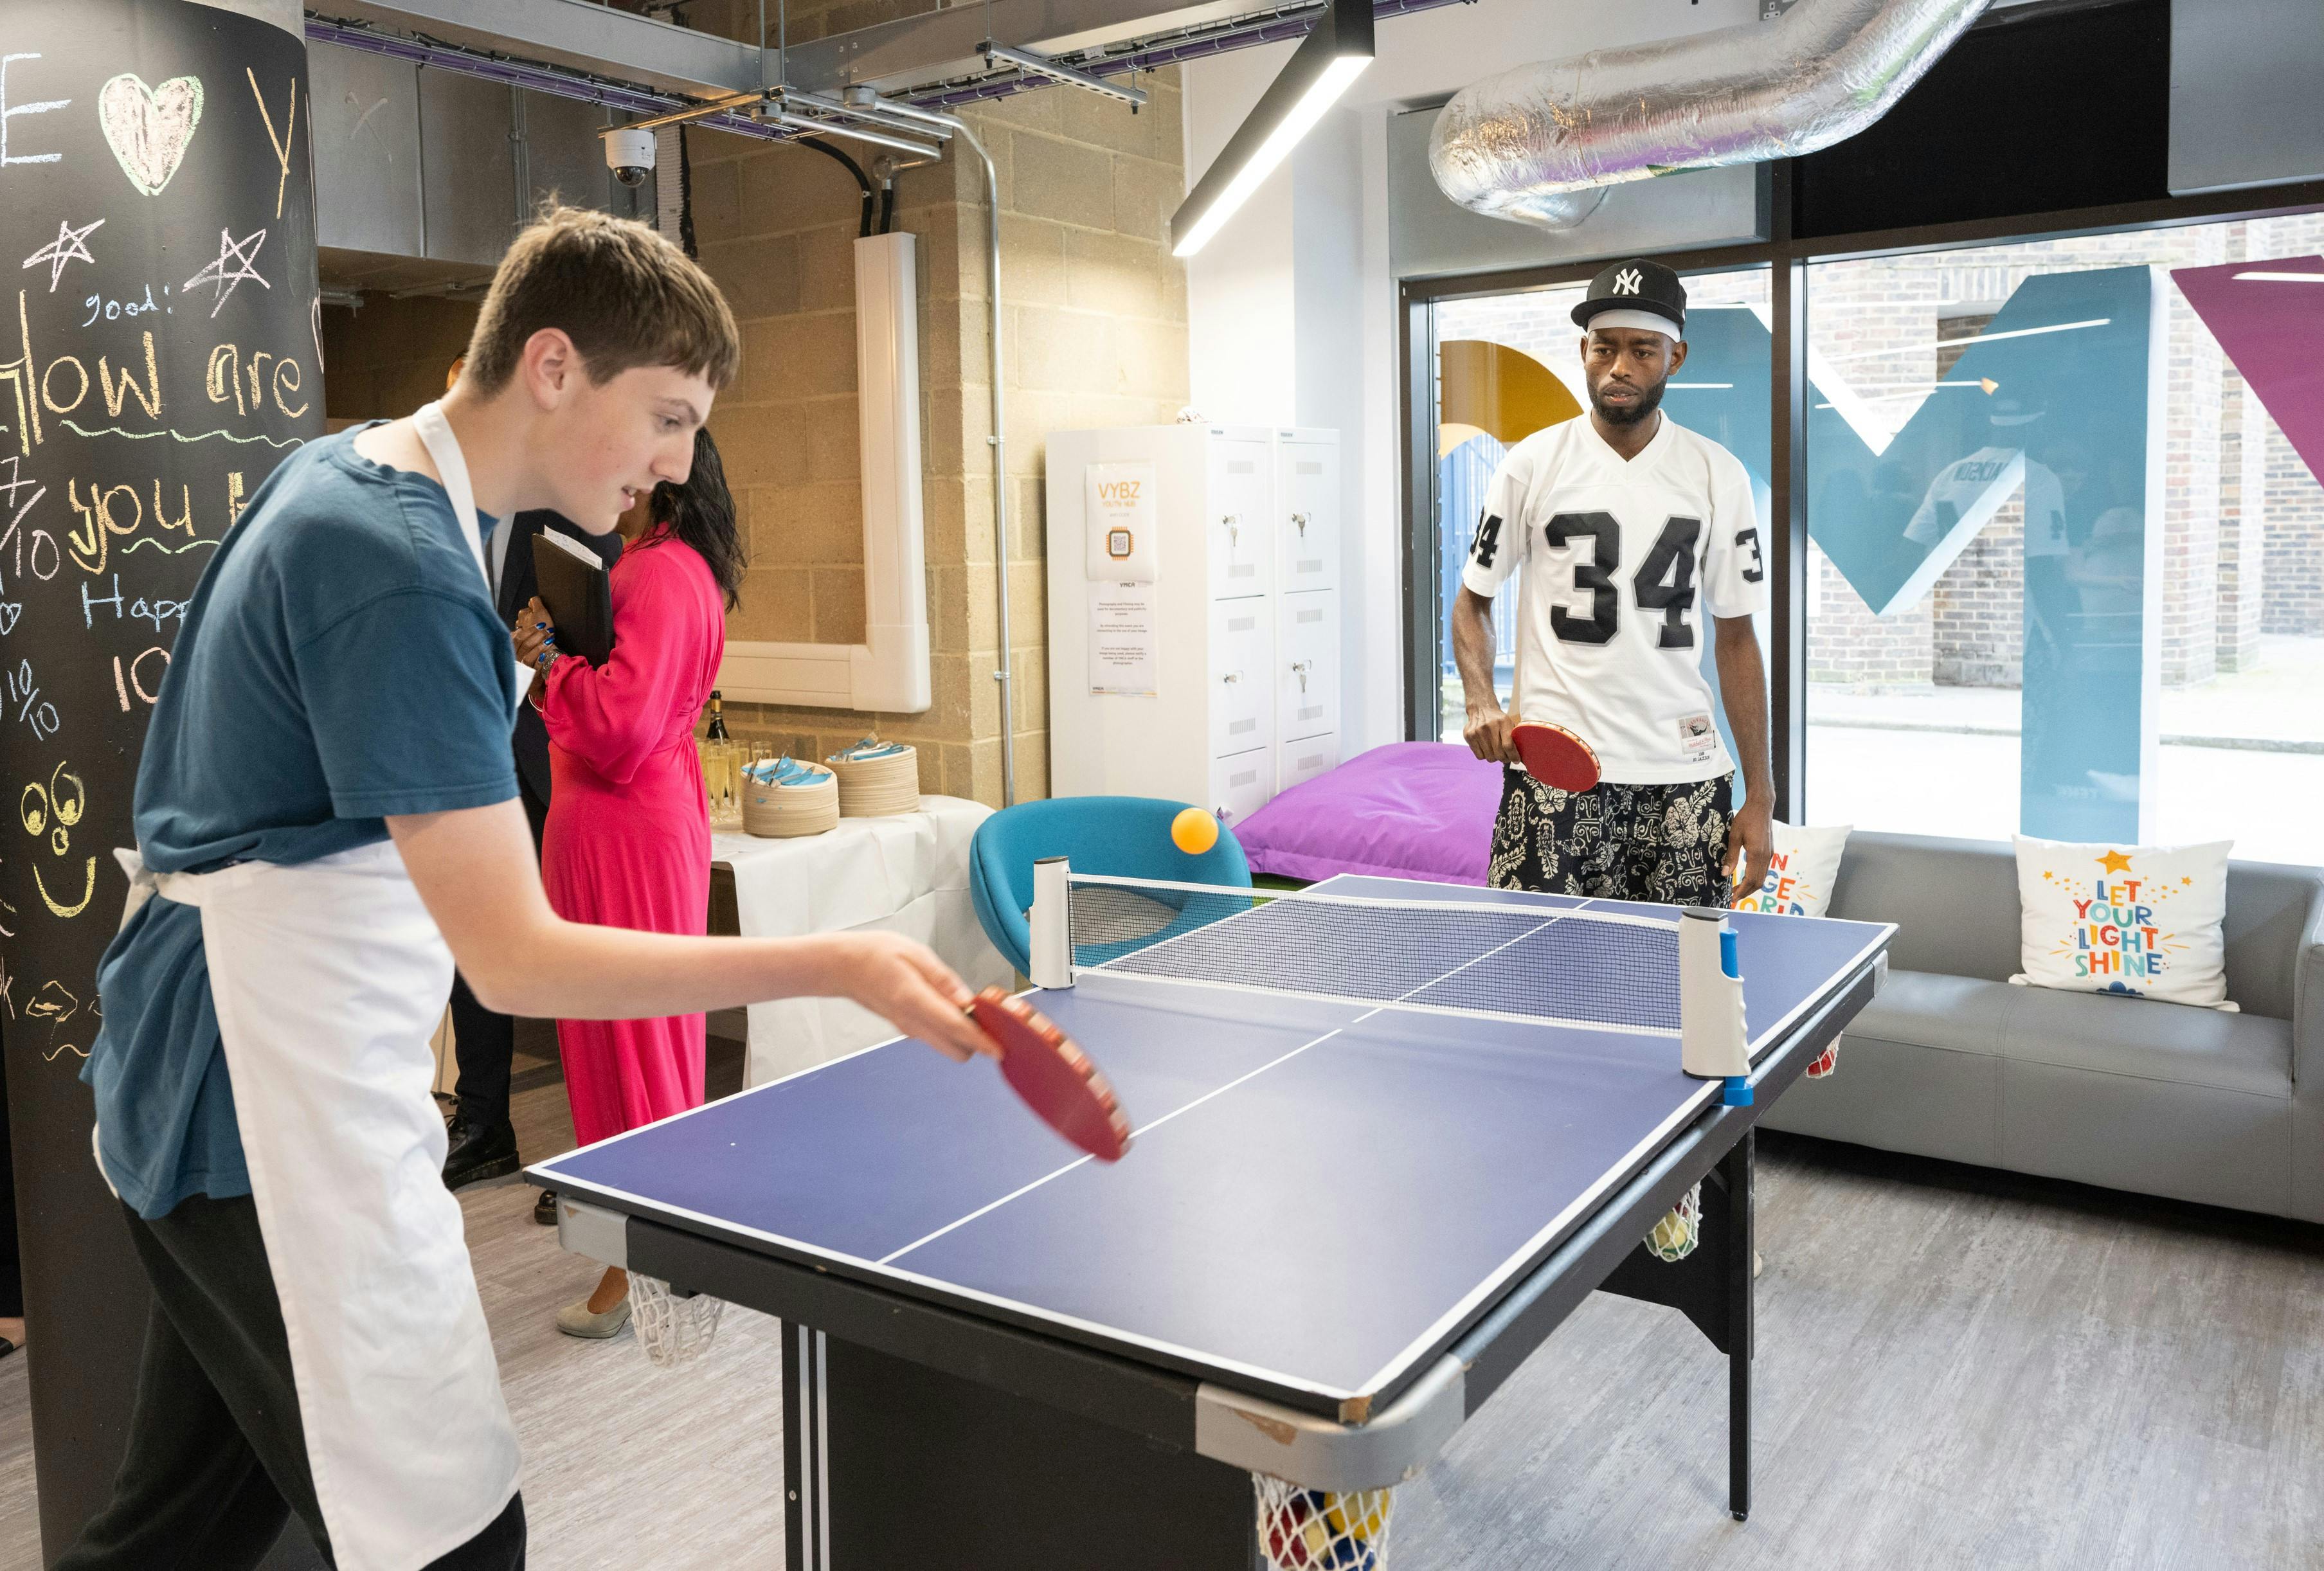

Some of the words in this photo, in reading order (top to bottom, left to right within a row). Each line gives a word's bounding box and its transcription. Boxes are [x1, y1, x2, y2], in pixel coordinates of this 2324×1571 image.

[206, 344, 309, 419] are
[1098, 480, 1140, 499] VYBZ
[69, 477, 195, 575] you
[1544, 510, 1702, 651] 34
[82, 573, 193, 633] Happ
[2097, 880, 2141, 907] LET
[2073, 899, 2152, 928] YOUR
[2078, 924, 2159, 953] LIGHT
[2075, 949, 2163, 978] SHINE
